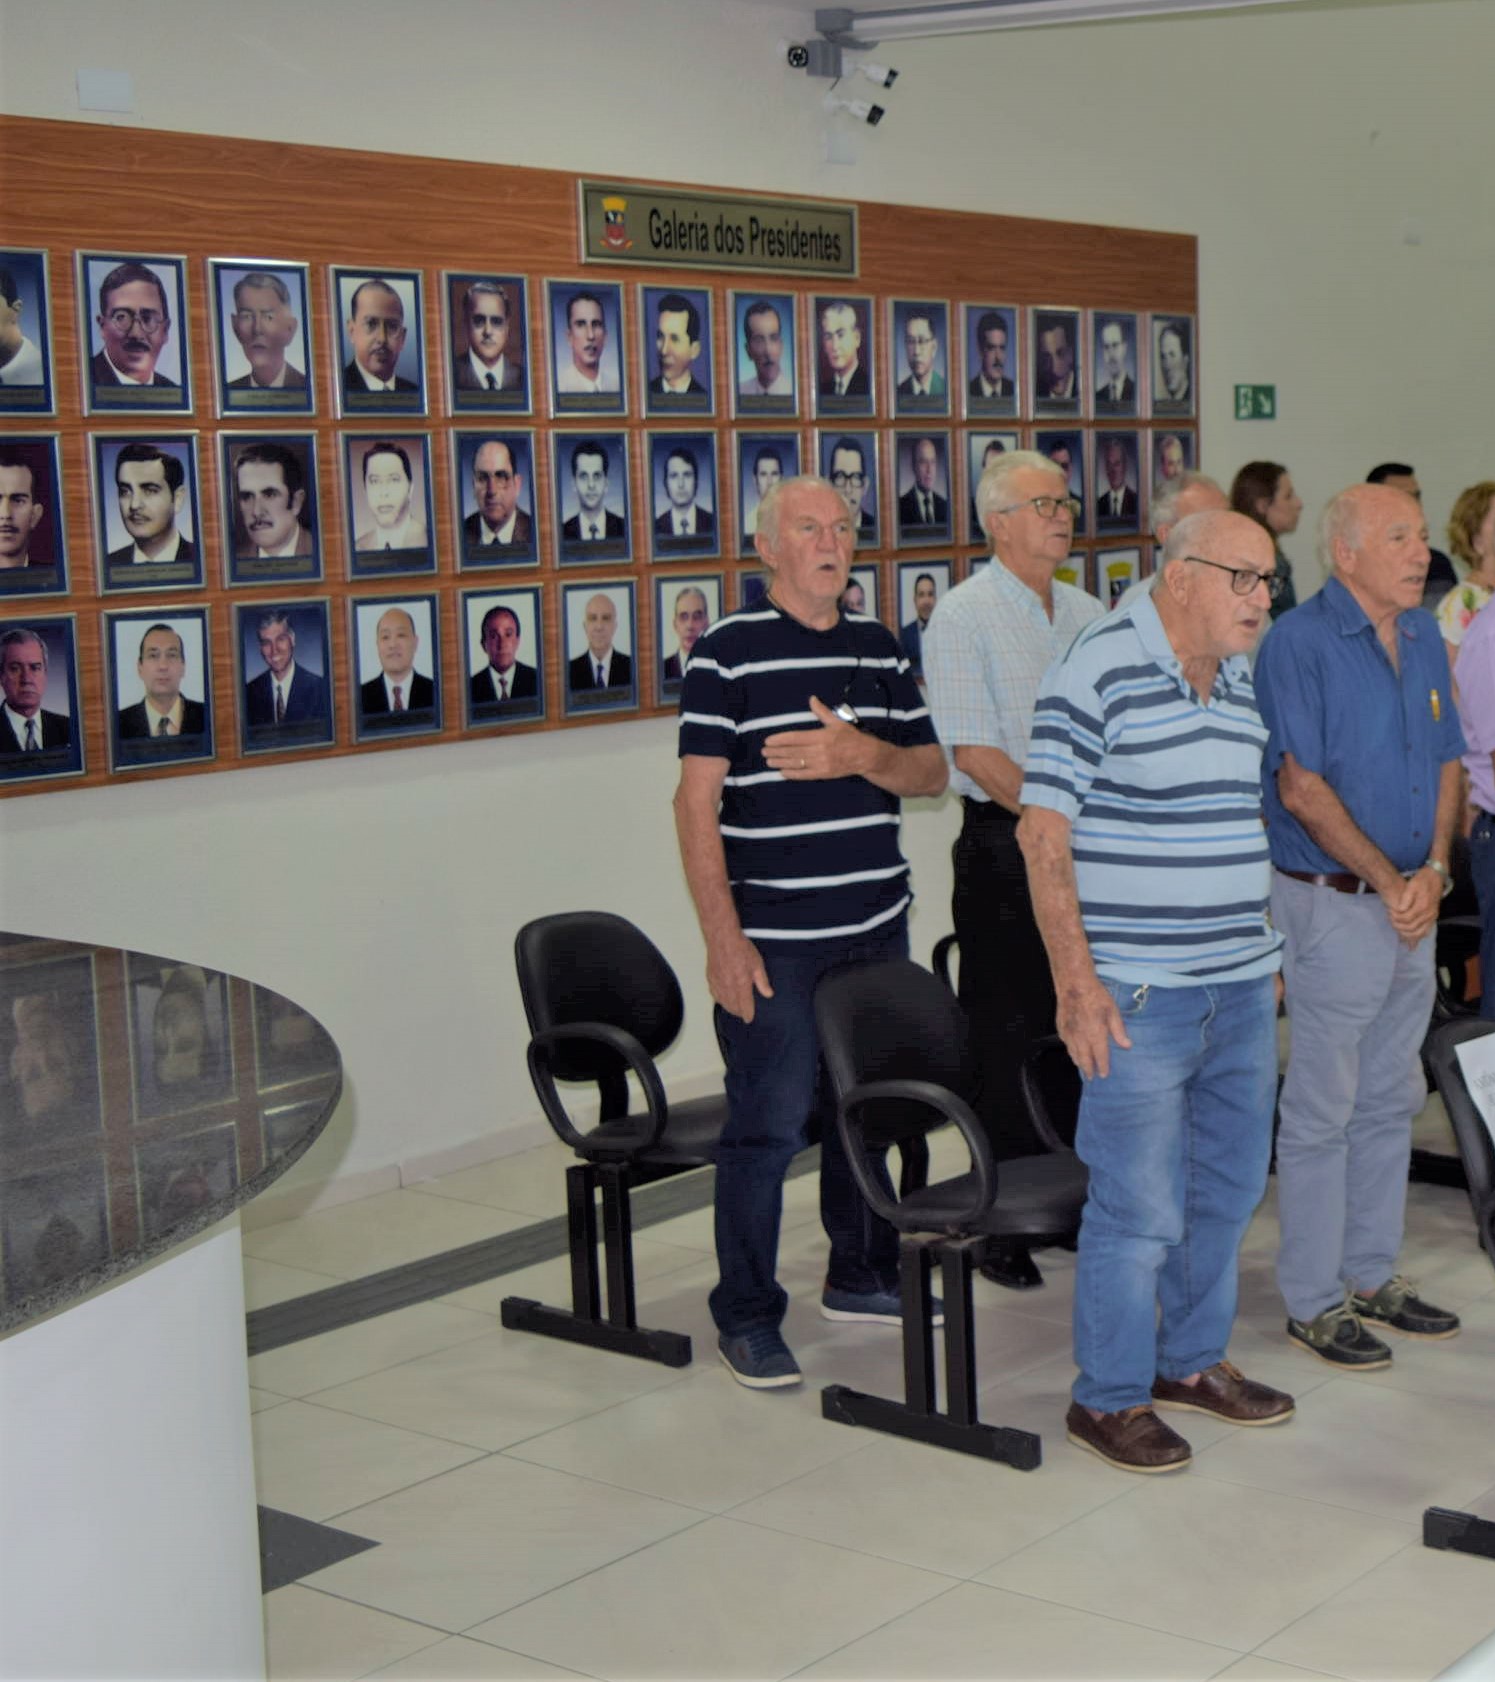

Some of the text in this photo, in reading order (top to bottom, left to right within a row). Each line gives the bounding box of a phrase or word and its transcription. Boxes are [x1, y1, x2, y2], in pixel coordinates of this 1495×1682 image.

[649, 207, 842, 262] Galeria dos Presidentes
